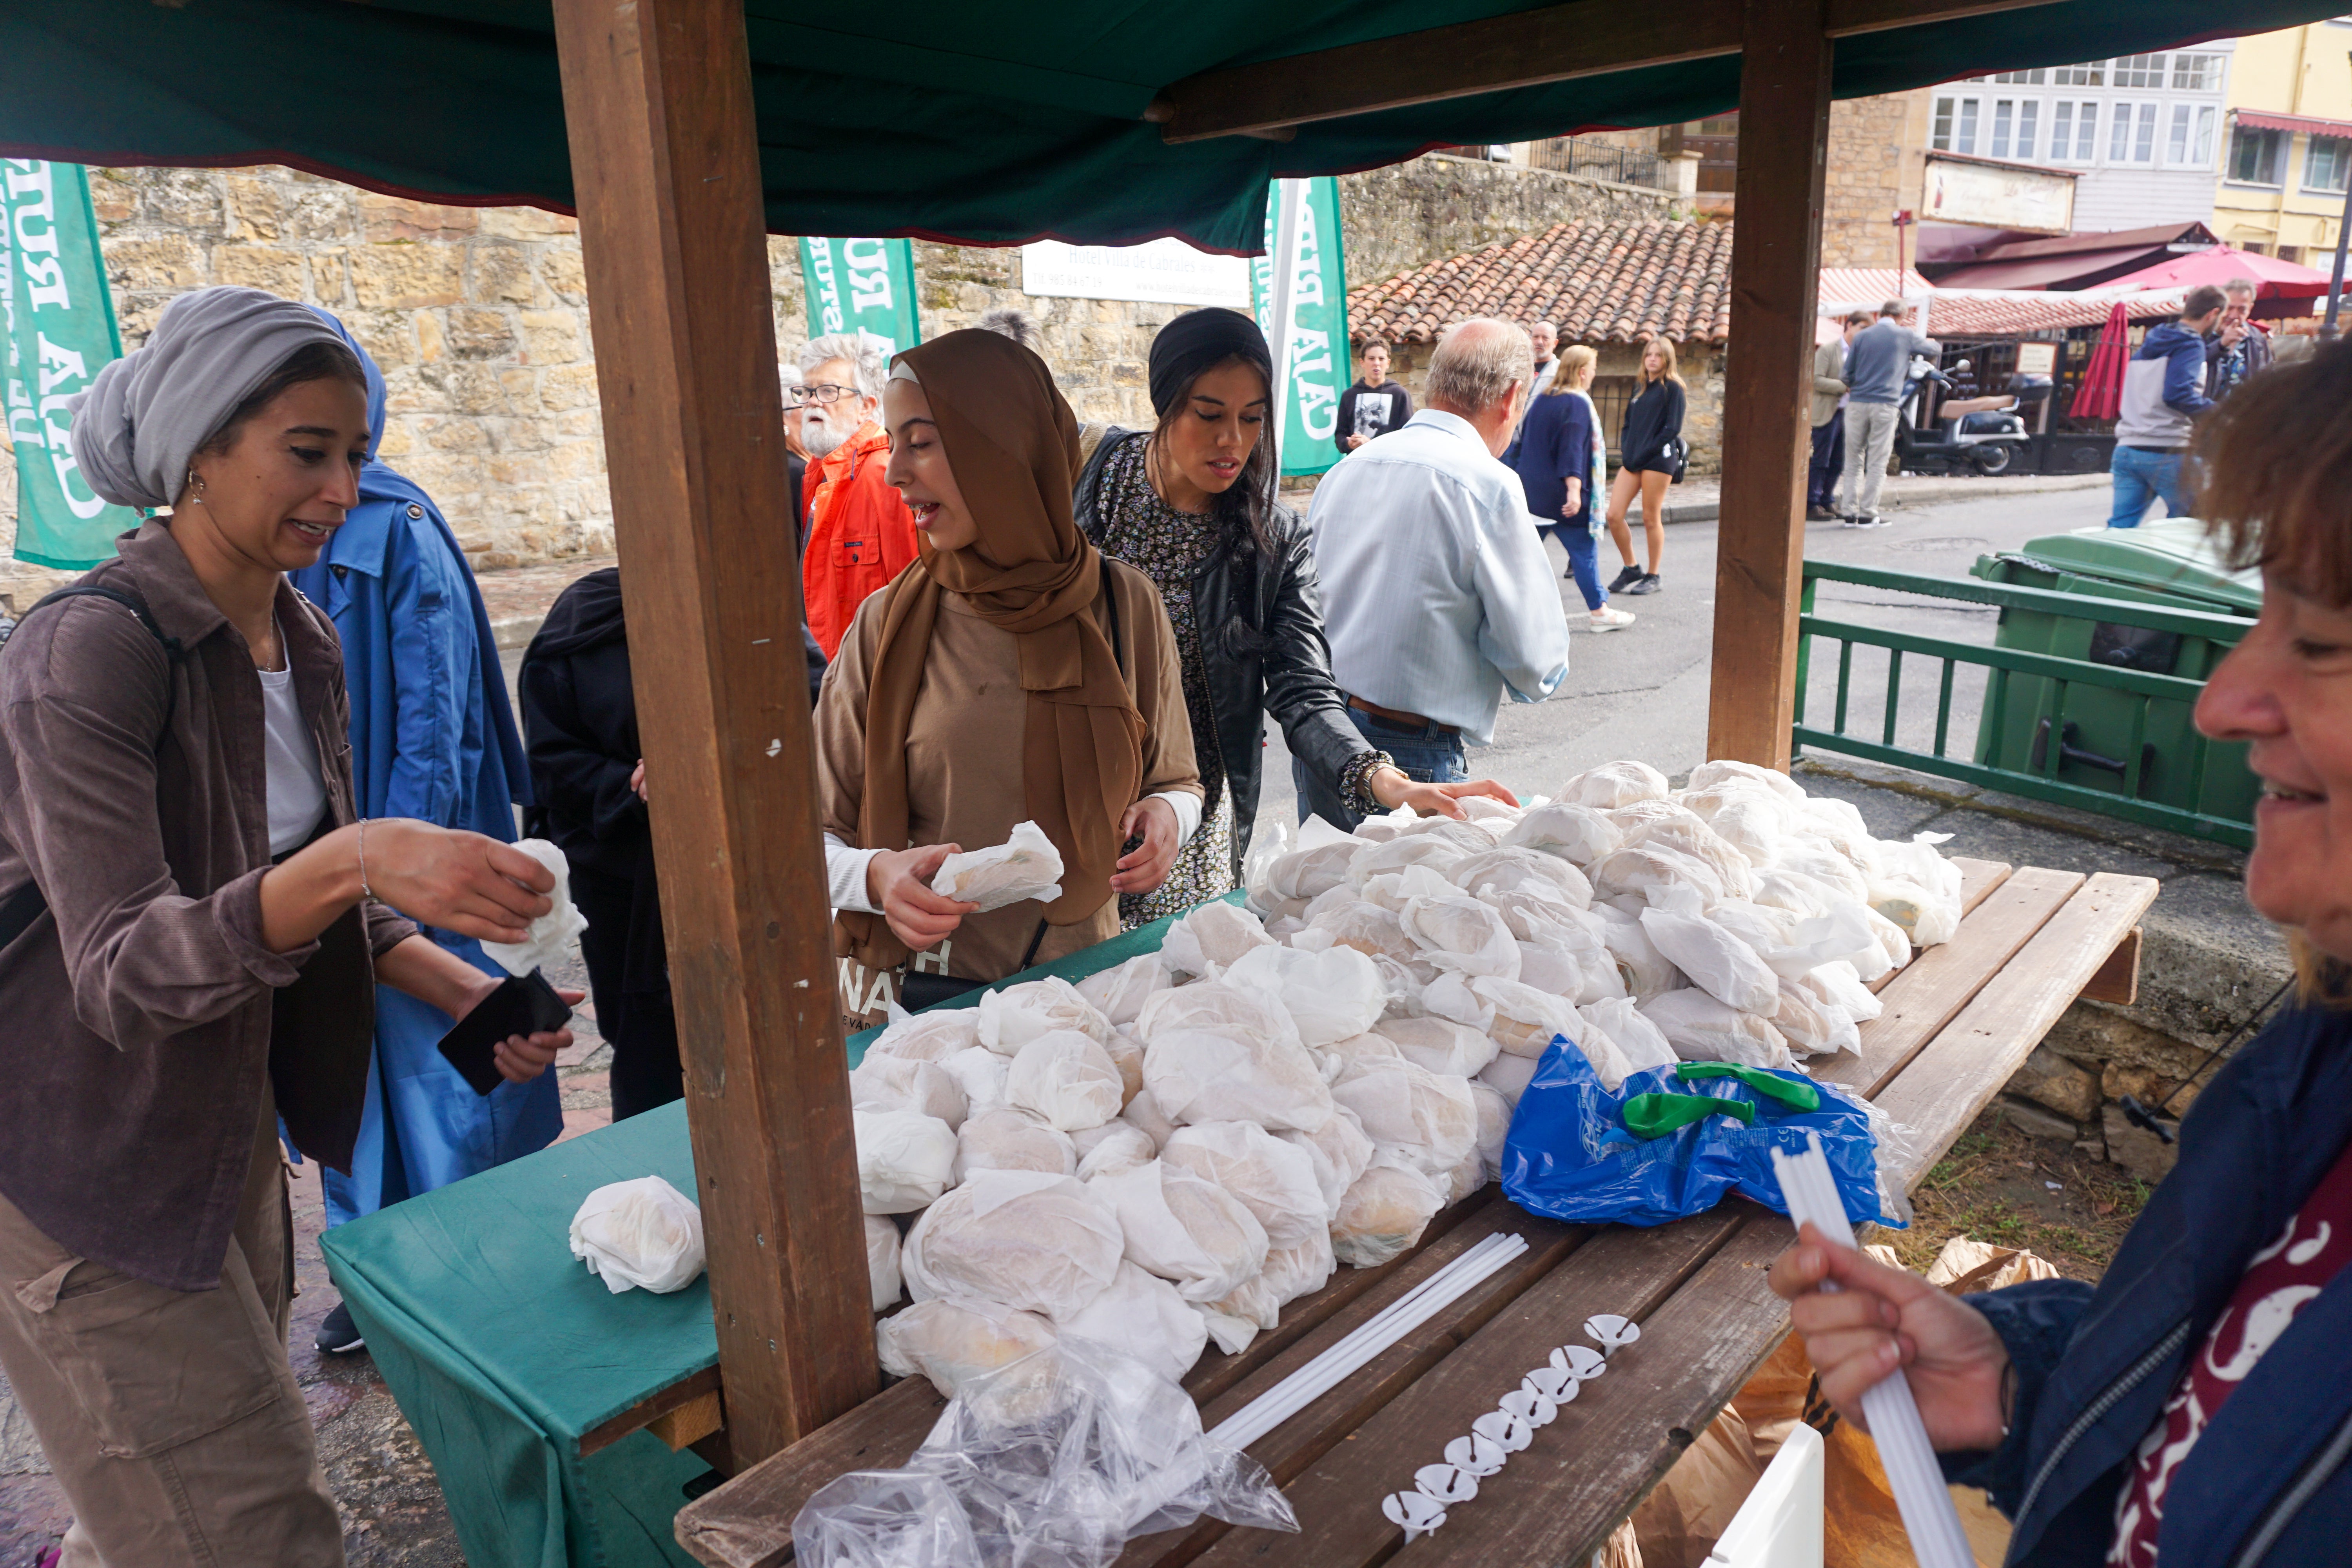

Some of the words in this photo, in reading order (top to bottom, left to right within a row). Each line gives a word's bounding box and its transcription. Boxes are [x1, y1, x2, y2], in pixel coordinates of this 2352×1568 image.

[1069, 245, 1101, 265] Hotel
[1103, 248, 1129, 267] Villa
[1133, 251, 1145, 269] de
[1149, 253, 1196, 272] Cabrales
[843, 1015, 877, 1031] EVAD
